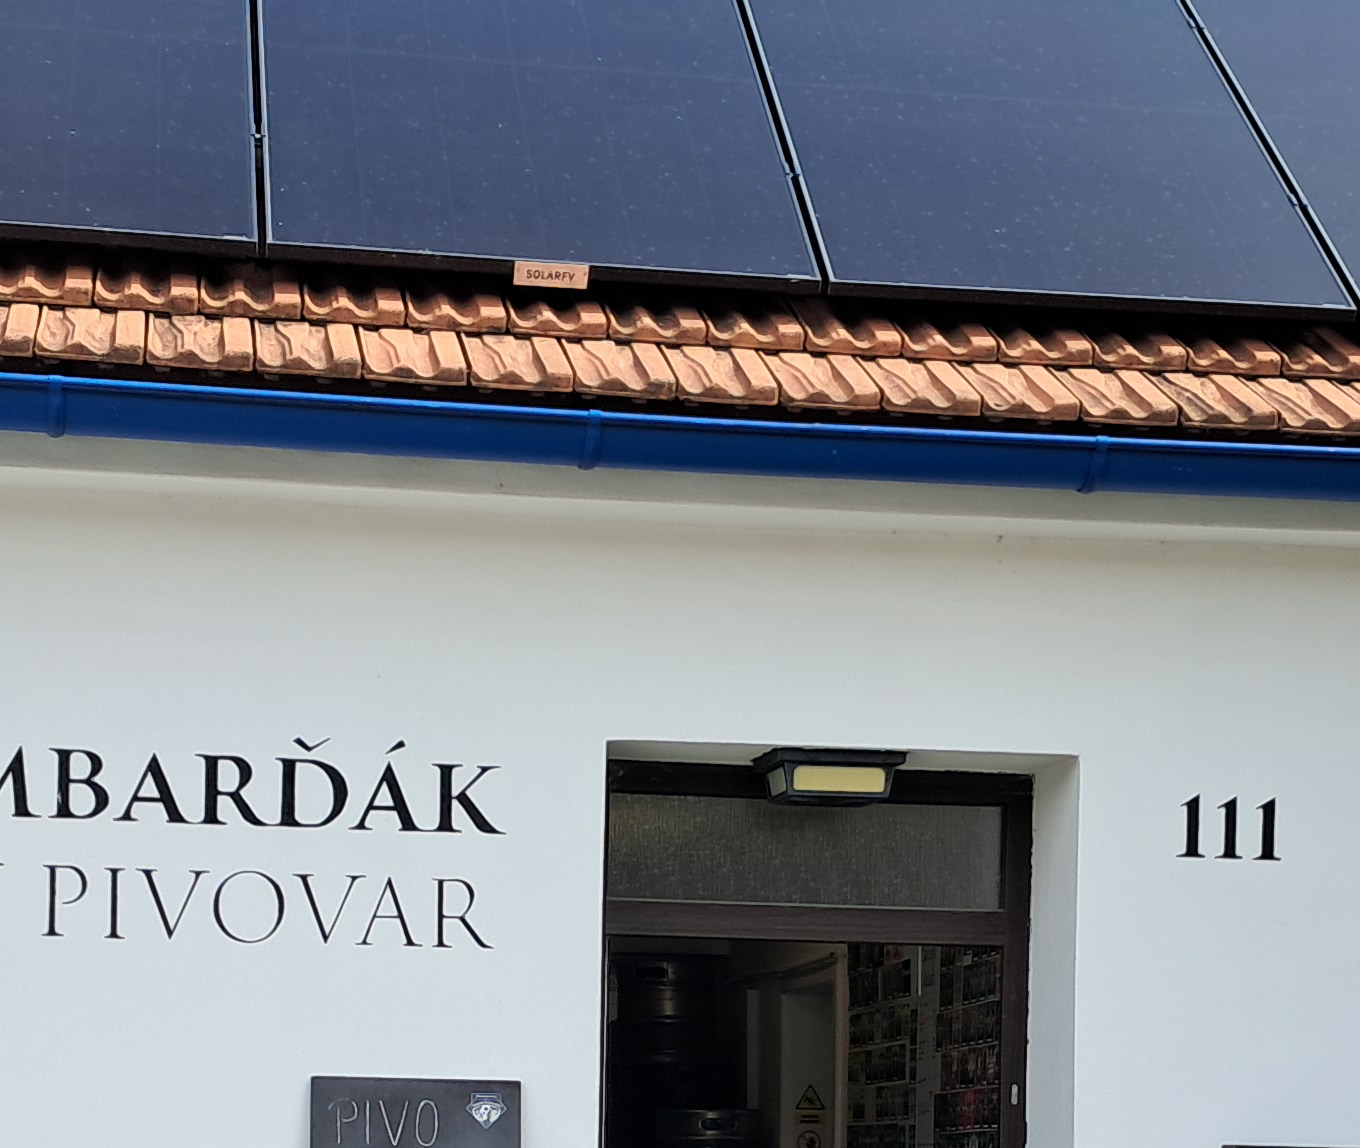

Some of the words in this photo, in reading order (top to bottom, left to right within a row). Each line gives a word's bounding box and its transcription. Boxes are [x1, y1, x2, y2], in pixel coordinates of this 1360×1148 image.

[1175, 793, 1282, 861] 111
[41, 863, 495, 950] PIVOVAR
[327, 1097, 439, 1147] PIVO
